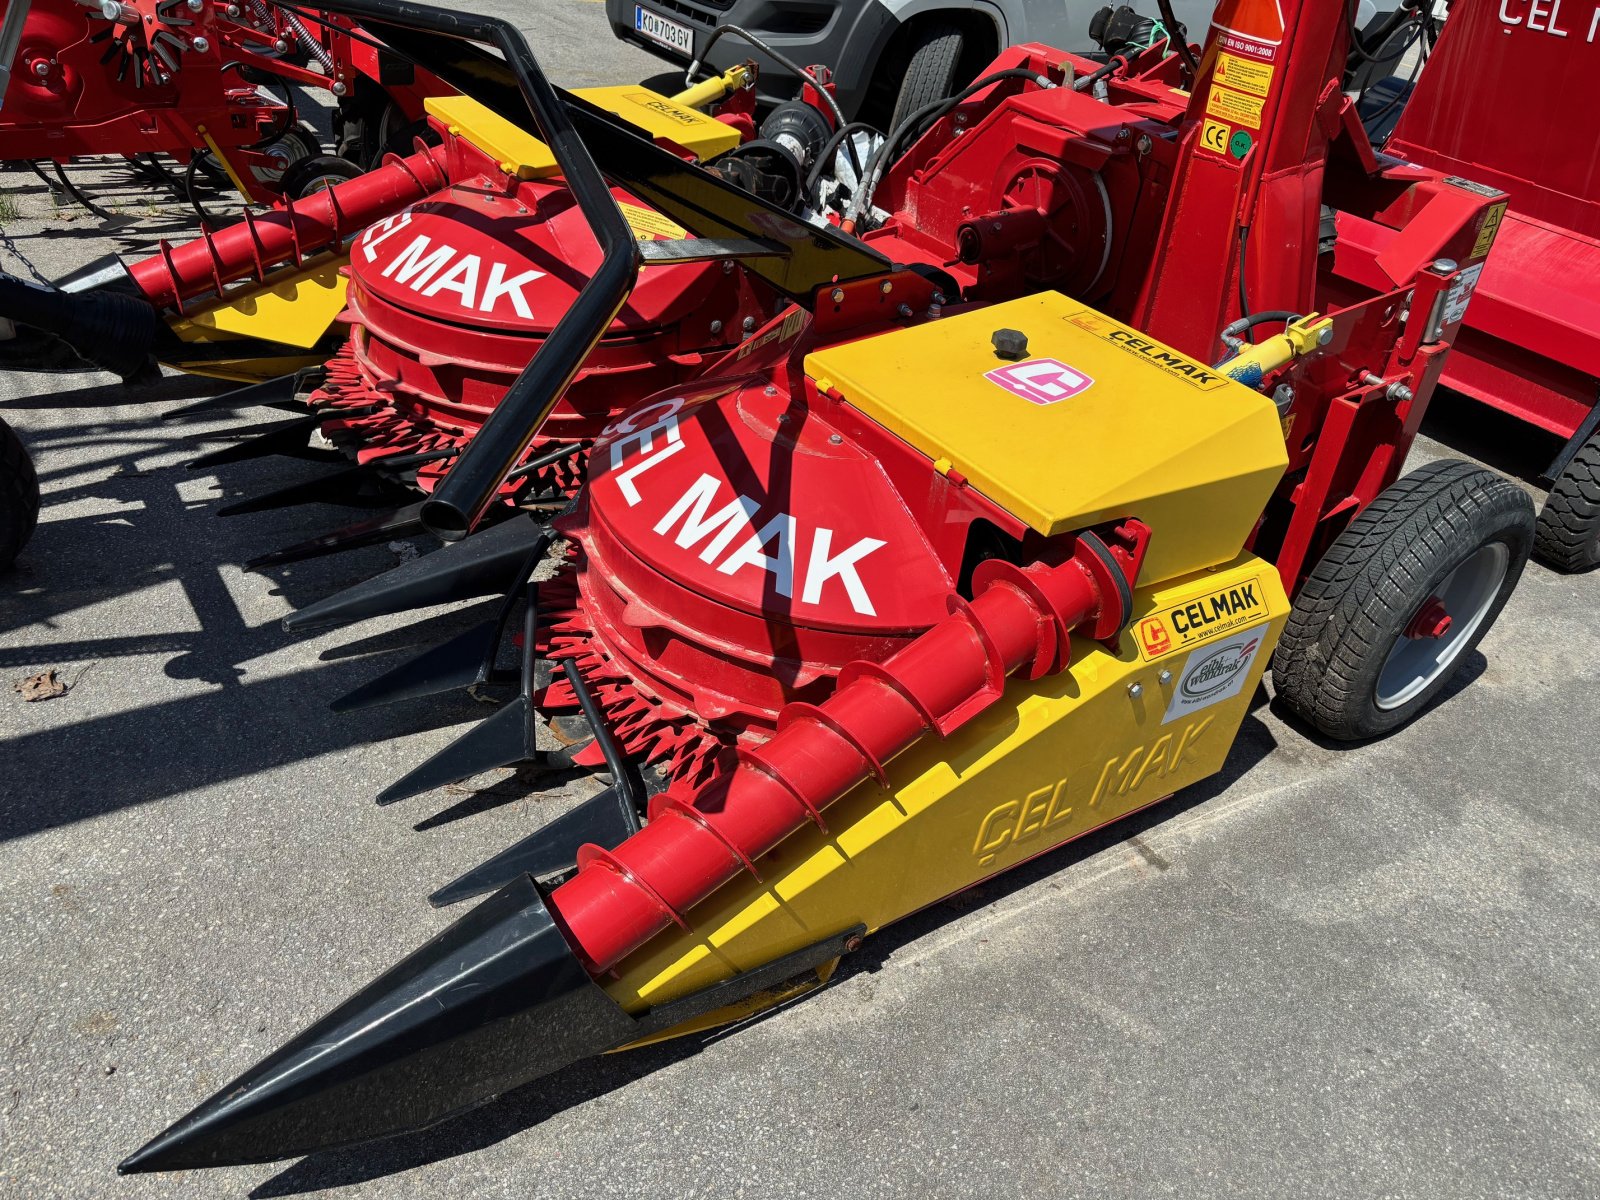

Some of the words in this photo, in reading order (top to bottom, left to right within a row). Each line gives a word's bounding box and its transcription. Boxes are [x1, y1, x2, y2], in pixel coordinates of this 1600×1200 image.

[1498, 0, 1568, 37] ÇEL
[1227, 38, 1236, 48] EN
[1235, 40, 1245, 50] ISO
[1245, 43, 1273, 57] 9001:2008
[381, 234, 547, 320] MAK
[1109, 330, 1219, 384] ÇELMAK
[1120, 344, 1181, 377] www.celmak.com
[652, 472, 889, 617] MAK
[1171, 583, 1260, 639] ÇELMAK
[1197, 615, 1248, 639] www.celmak.com
[972, 777, 1073, 868] ÇEL
[1088, 713, 1216, 808] MAK
